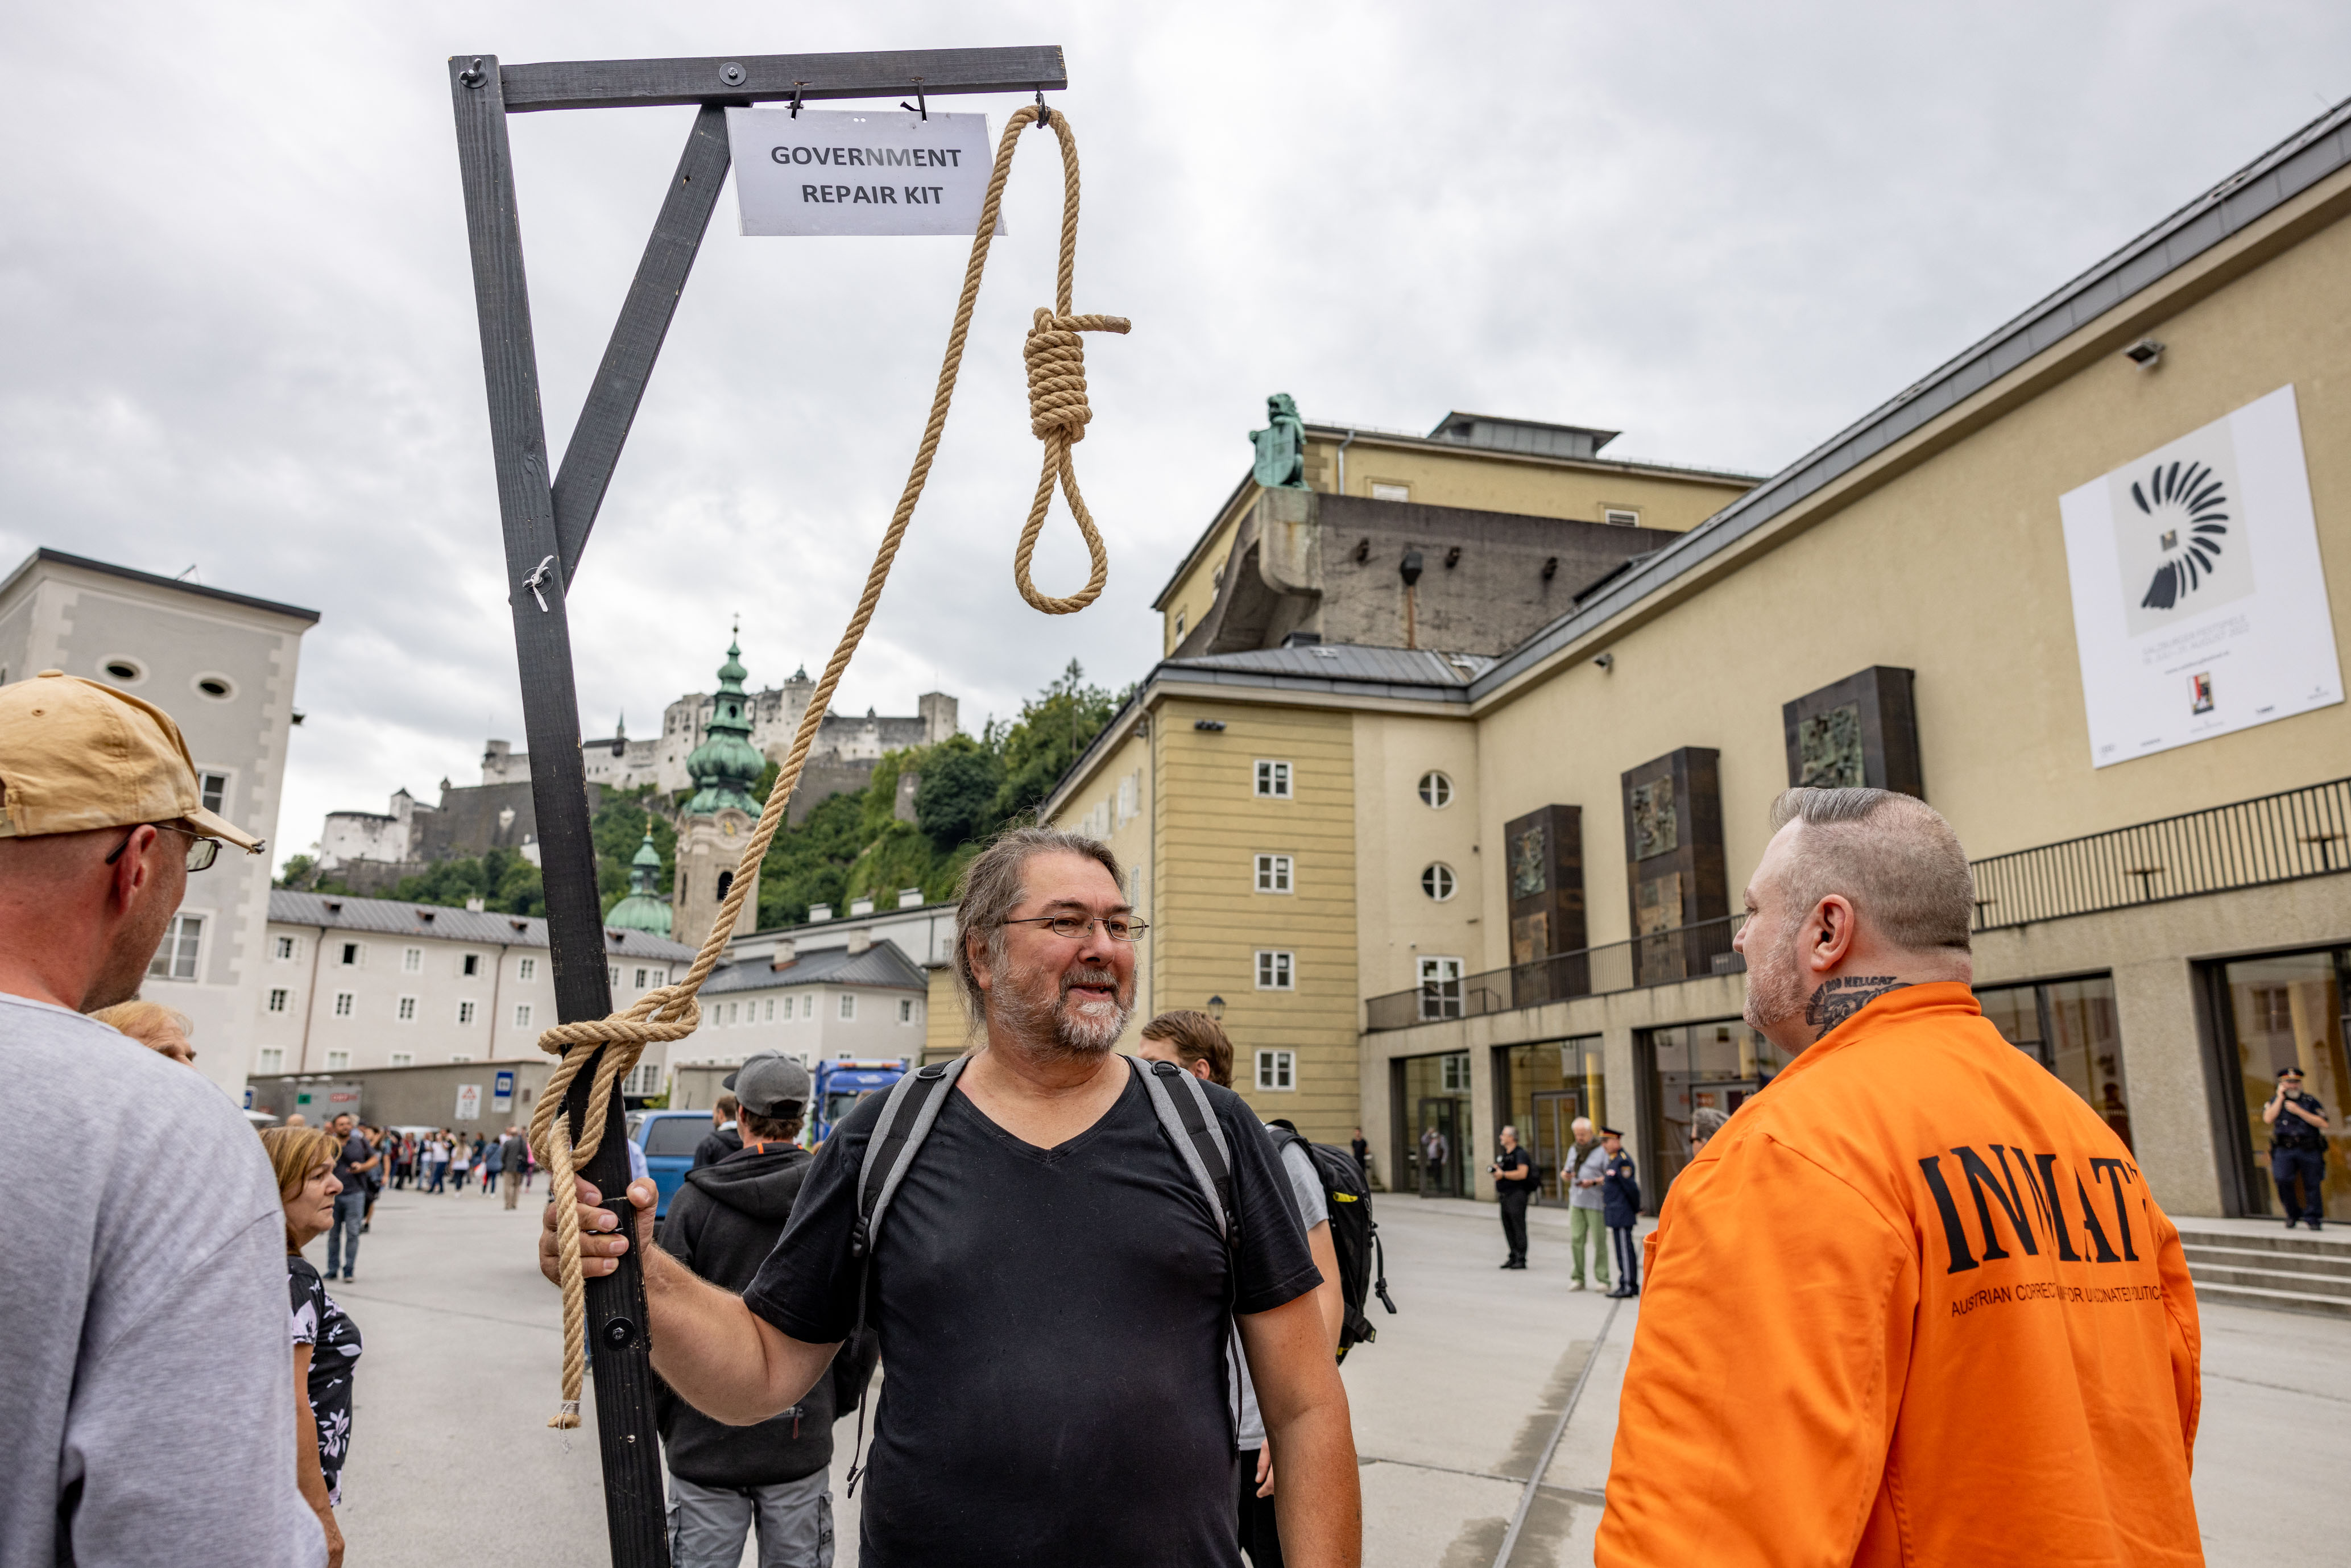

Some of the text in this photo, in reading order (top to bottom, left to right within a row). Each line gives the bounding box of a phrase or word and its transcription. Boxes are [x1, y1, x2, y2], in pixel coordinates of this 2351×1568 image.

[771, 146, 961, 167] GOVERNMENT
[802, 184, 943, 204] REPAIR KIT
[1844, 976, 1897, 988] HELLCAT
[1918, 1144, 2146, 1275] INMAT
[1951, 1286, 2012, 1317] AUSTRIAN
[2015, 1282, 2056, 1301] CORREC
